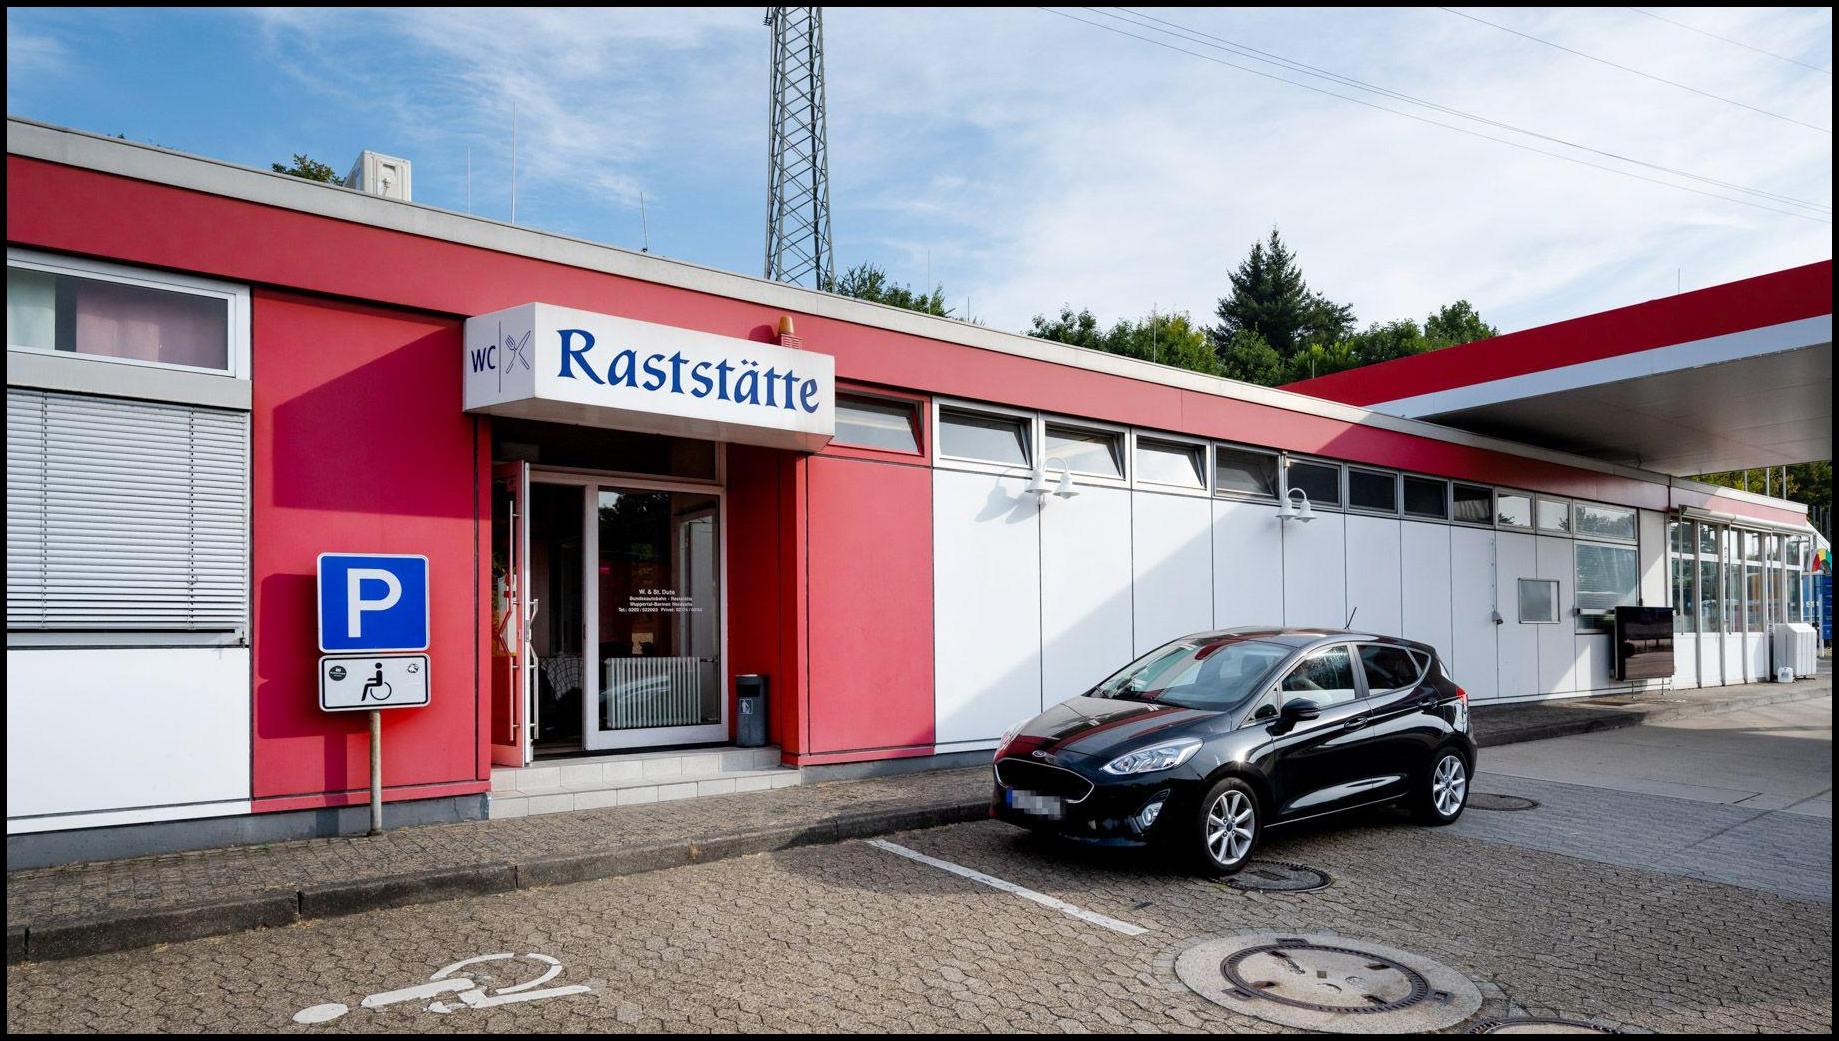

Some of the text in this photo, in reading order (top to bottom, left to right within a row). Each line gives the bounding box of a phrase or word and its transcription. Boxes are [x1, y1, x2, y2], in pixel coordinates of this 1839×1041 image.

[470, 345, 496, 373] WC
[557, 328, 819, 413] Raststätte
[347, 568, 403, 639] P
